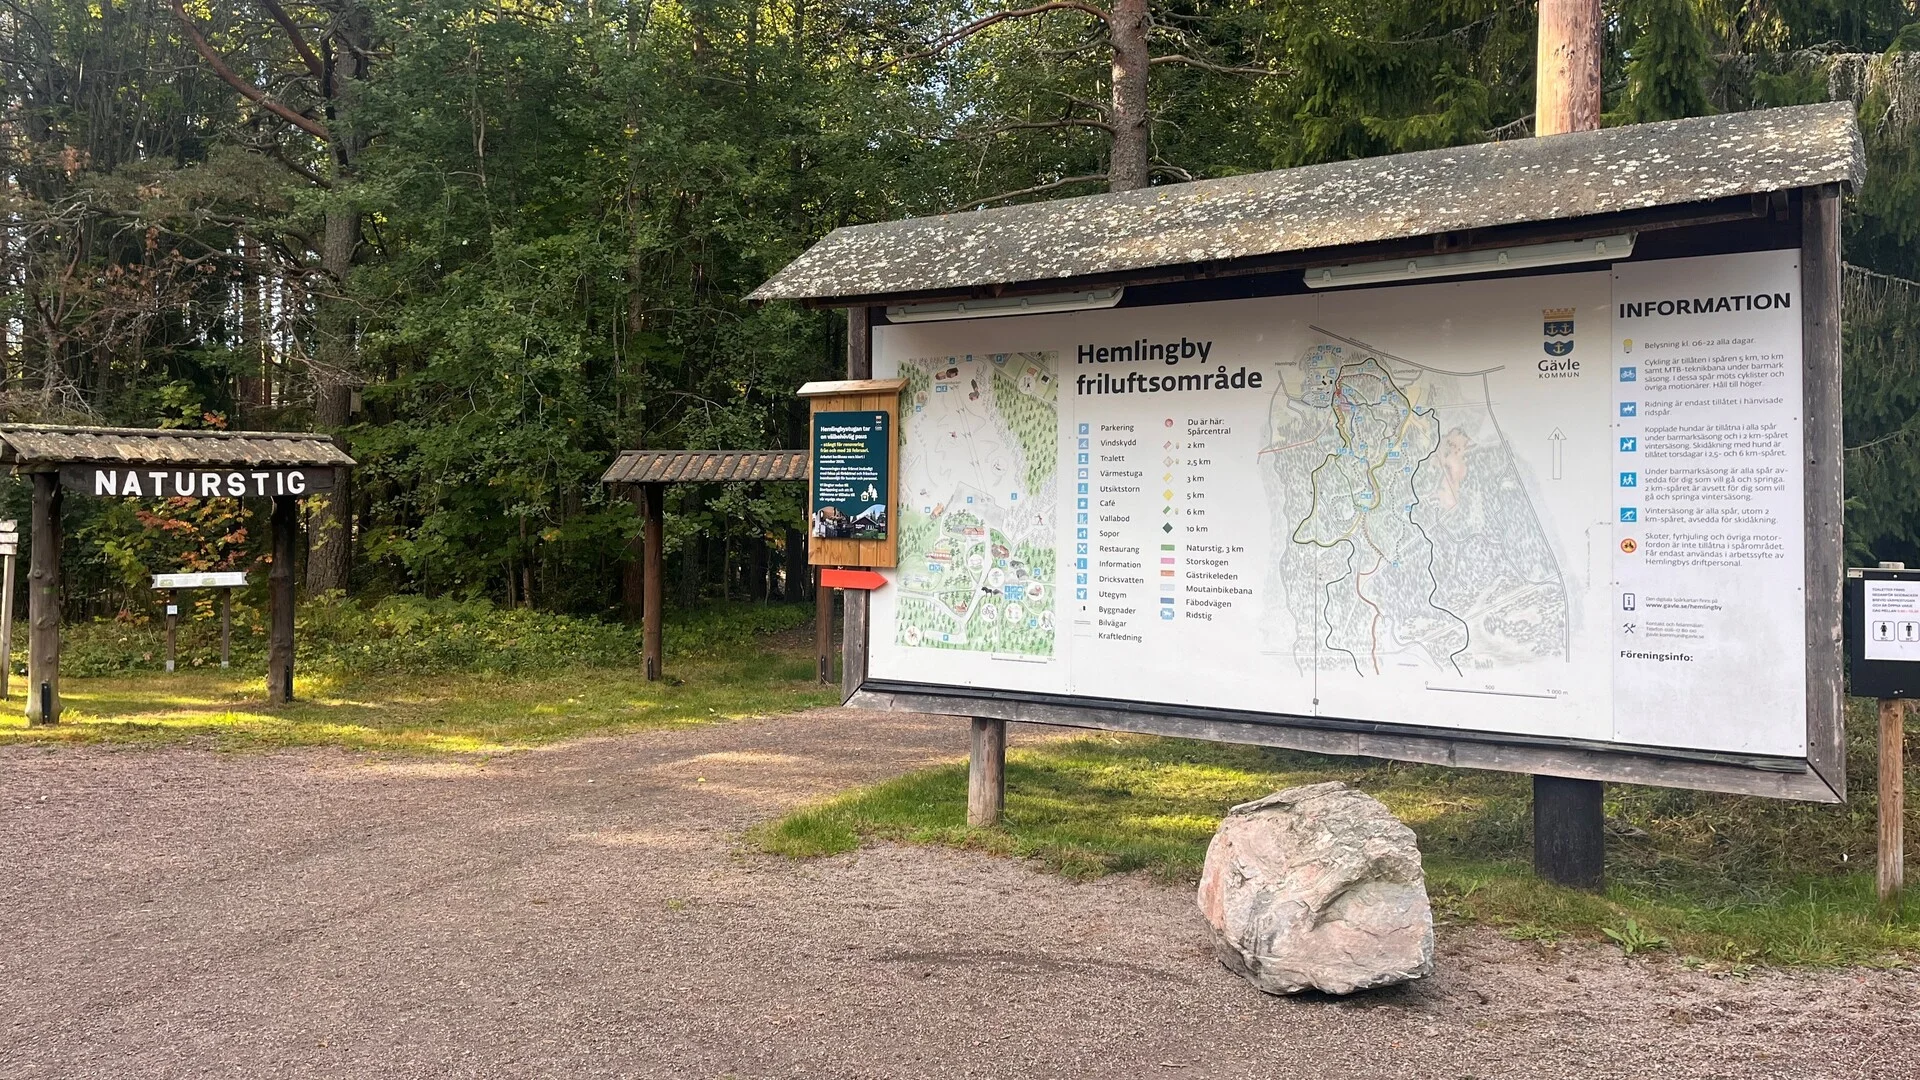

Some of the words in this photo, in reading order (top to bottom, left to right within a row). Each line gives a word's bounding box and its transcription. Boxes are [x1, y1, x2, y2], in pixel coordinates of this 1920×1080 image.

[1619, 292, 1790, 318] INFORMATION
[1644, 341, 1679, 349] Belysning
[1078, 337, 1212, 364] Hemlingby
[1538, 359, 1580, 371] Gävle
[1664, 364, 1725, 372] MTB-teknikbana
[1077, 366, 1262, 395] friluftsområde
[1644, 401, 1673, 409] Ridning
[1100, 424, 1134, 432] Parkering
[1187, 427, 1230, 436] Spårcentral
[1644, 425, 1677, 433] Kopplade
[1760, 423, 1776, 432] spår
[1666, 433, 1722, 441] barmarksäsong
[1748, 431, 1788, 439] km-spåret
[1692, 441, 1732, 449] Skidåkning
[1099, 470, 1142, 478] Värmestuga
[1669, 467, 1728, 475] barmarksäsong
[1756, 466, 1772, 474] spår
[95, 470, 305, 496] NATURSTIG
[1680, 476, 1692, 484] dig
[1725, 475, 1735, 484] gå
[1650, 484, 1690, 493] km-spåret
[1740, 484, 1752, 492] dig
[1644, 493, 1654, 501] gå
[1701, 493, 1752, 501] vintersäsong.
[1644, 507, 1693, 516] Vintersäsong
[1721, 507, 1739, 515] spår,
[1644, 515, 1686, 523] km-spåret,
[1734, 516, 1777, 525] skidåkning.
[1099, 530, 1119, 538] Sopor
[1645, 532, 1670, 541] Skoter,
[1672, 533, 1708, 541] fyrhjuling
[1099, 545, 1139, 554] Restaurang
[1186, 544, 1224, 553] Naturstig,
[1698, 541, 1725, 549] tillåtna
[1731, 542, 1784, 550] spårområdet.
[1729, 551, 1772, 559] arbetssyfte
[1099, 560, 1141, 568] Information
[1186, 558, 1228, 567] Storskogen
[1645, 558, 1689, 566] Hemlingbys
[1691, 559, 1742, 567] driftpersonal.
[1099, 575, 1143, 583] Dricksvatten
[1185, 571, 1237, 580] Gästrikeleden
[1186, 585, 1252, 594] Moutainbikebana
[1098, 591, 1126, 599] Utegym
[1186, 598, 1231, 608] Fäbodvägen
[1098, 605, 1136, 615] Byggnader
[1186, 611, 1211, 621] Ridstig
[1098, 619, 1126, 628] Bilvägar
[1098, 632, 1142, 643] Kraftledning
[1620, 650, 1694, 661] Föreningsinfo:
